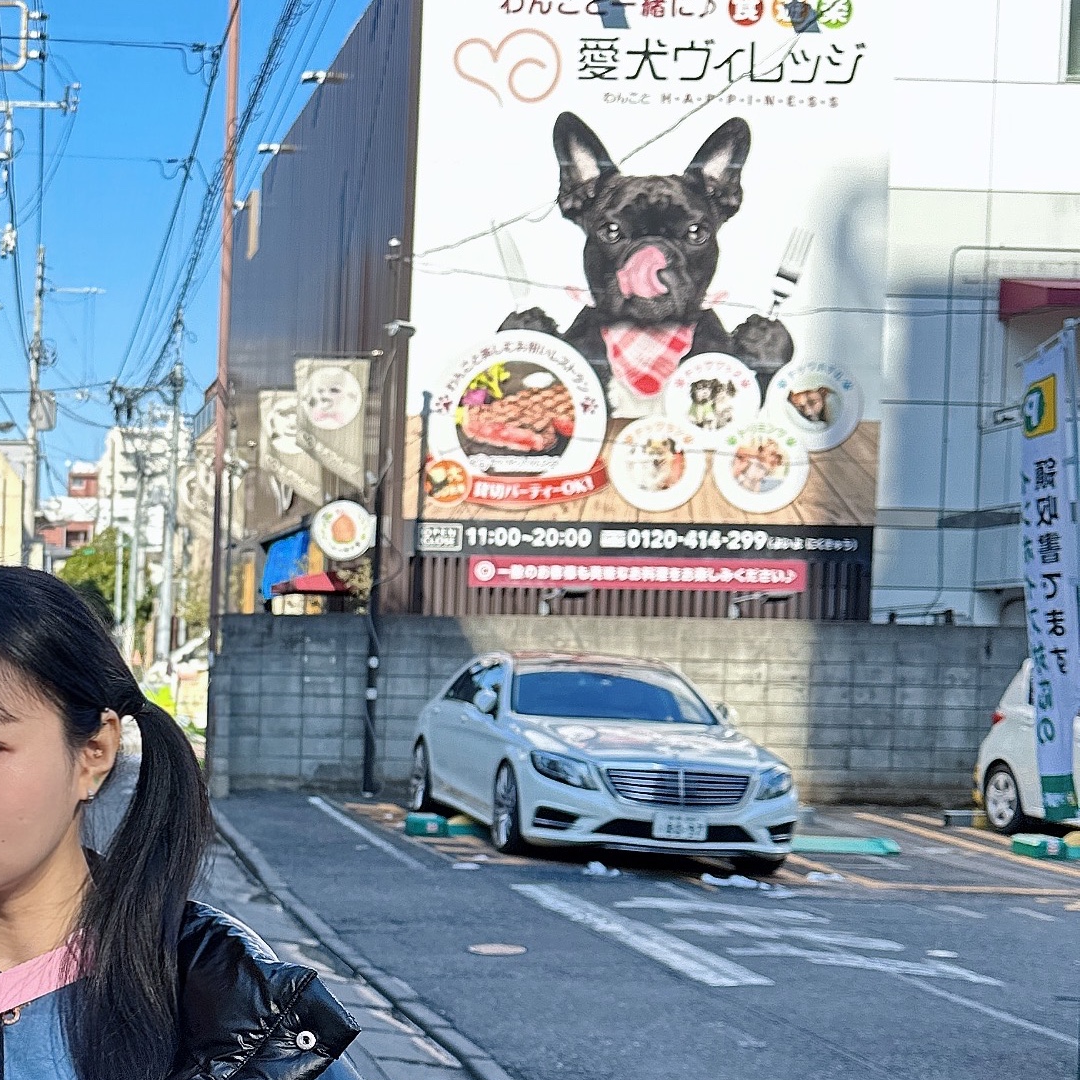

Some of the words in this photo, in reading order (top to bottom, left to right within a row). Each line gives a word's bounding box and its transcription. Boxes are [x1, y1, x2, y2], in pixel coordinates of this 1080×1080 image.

[578, 37, 867, 84] 愛犬ヴィレッジ
[626, 528, 769, 550] 0120-414-299
